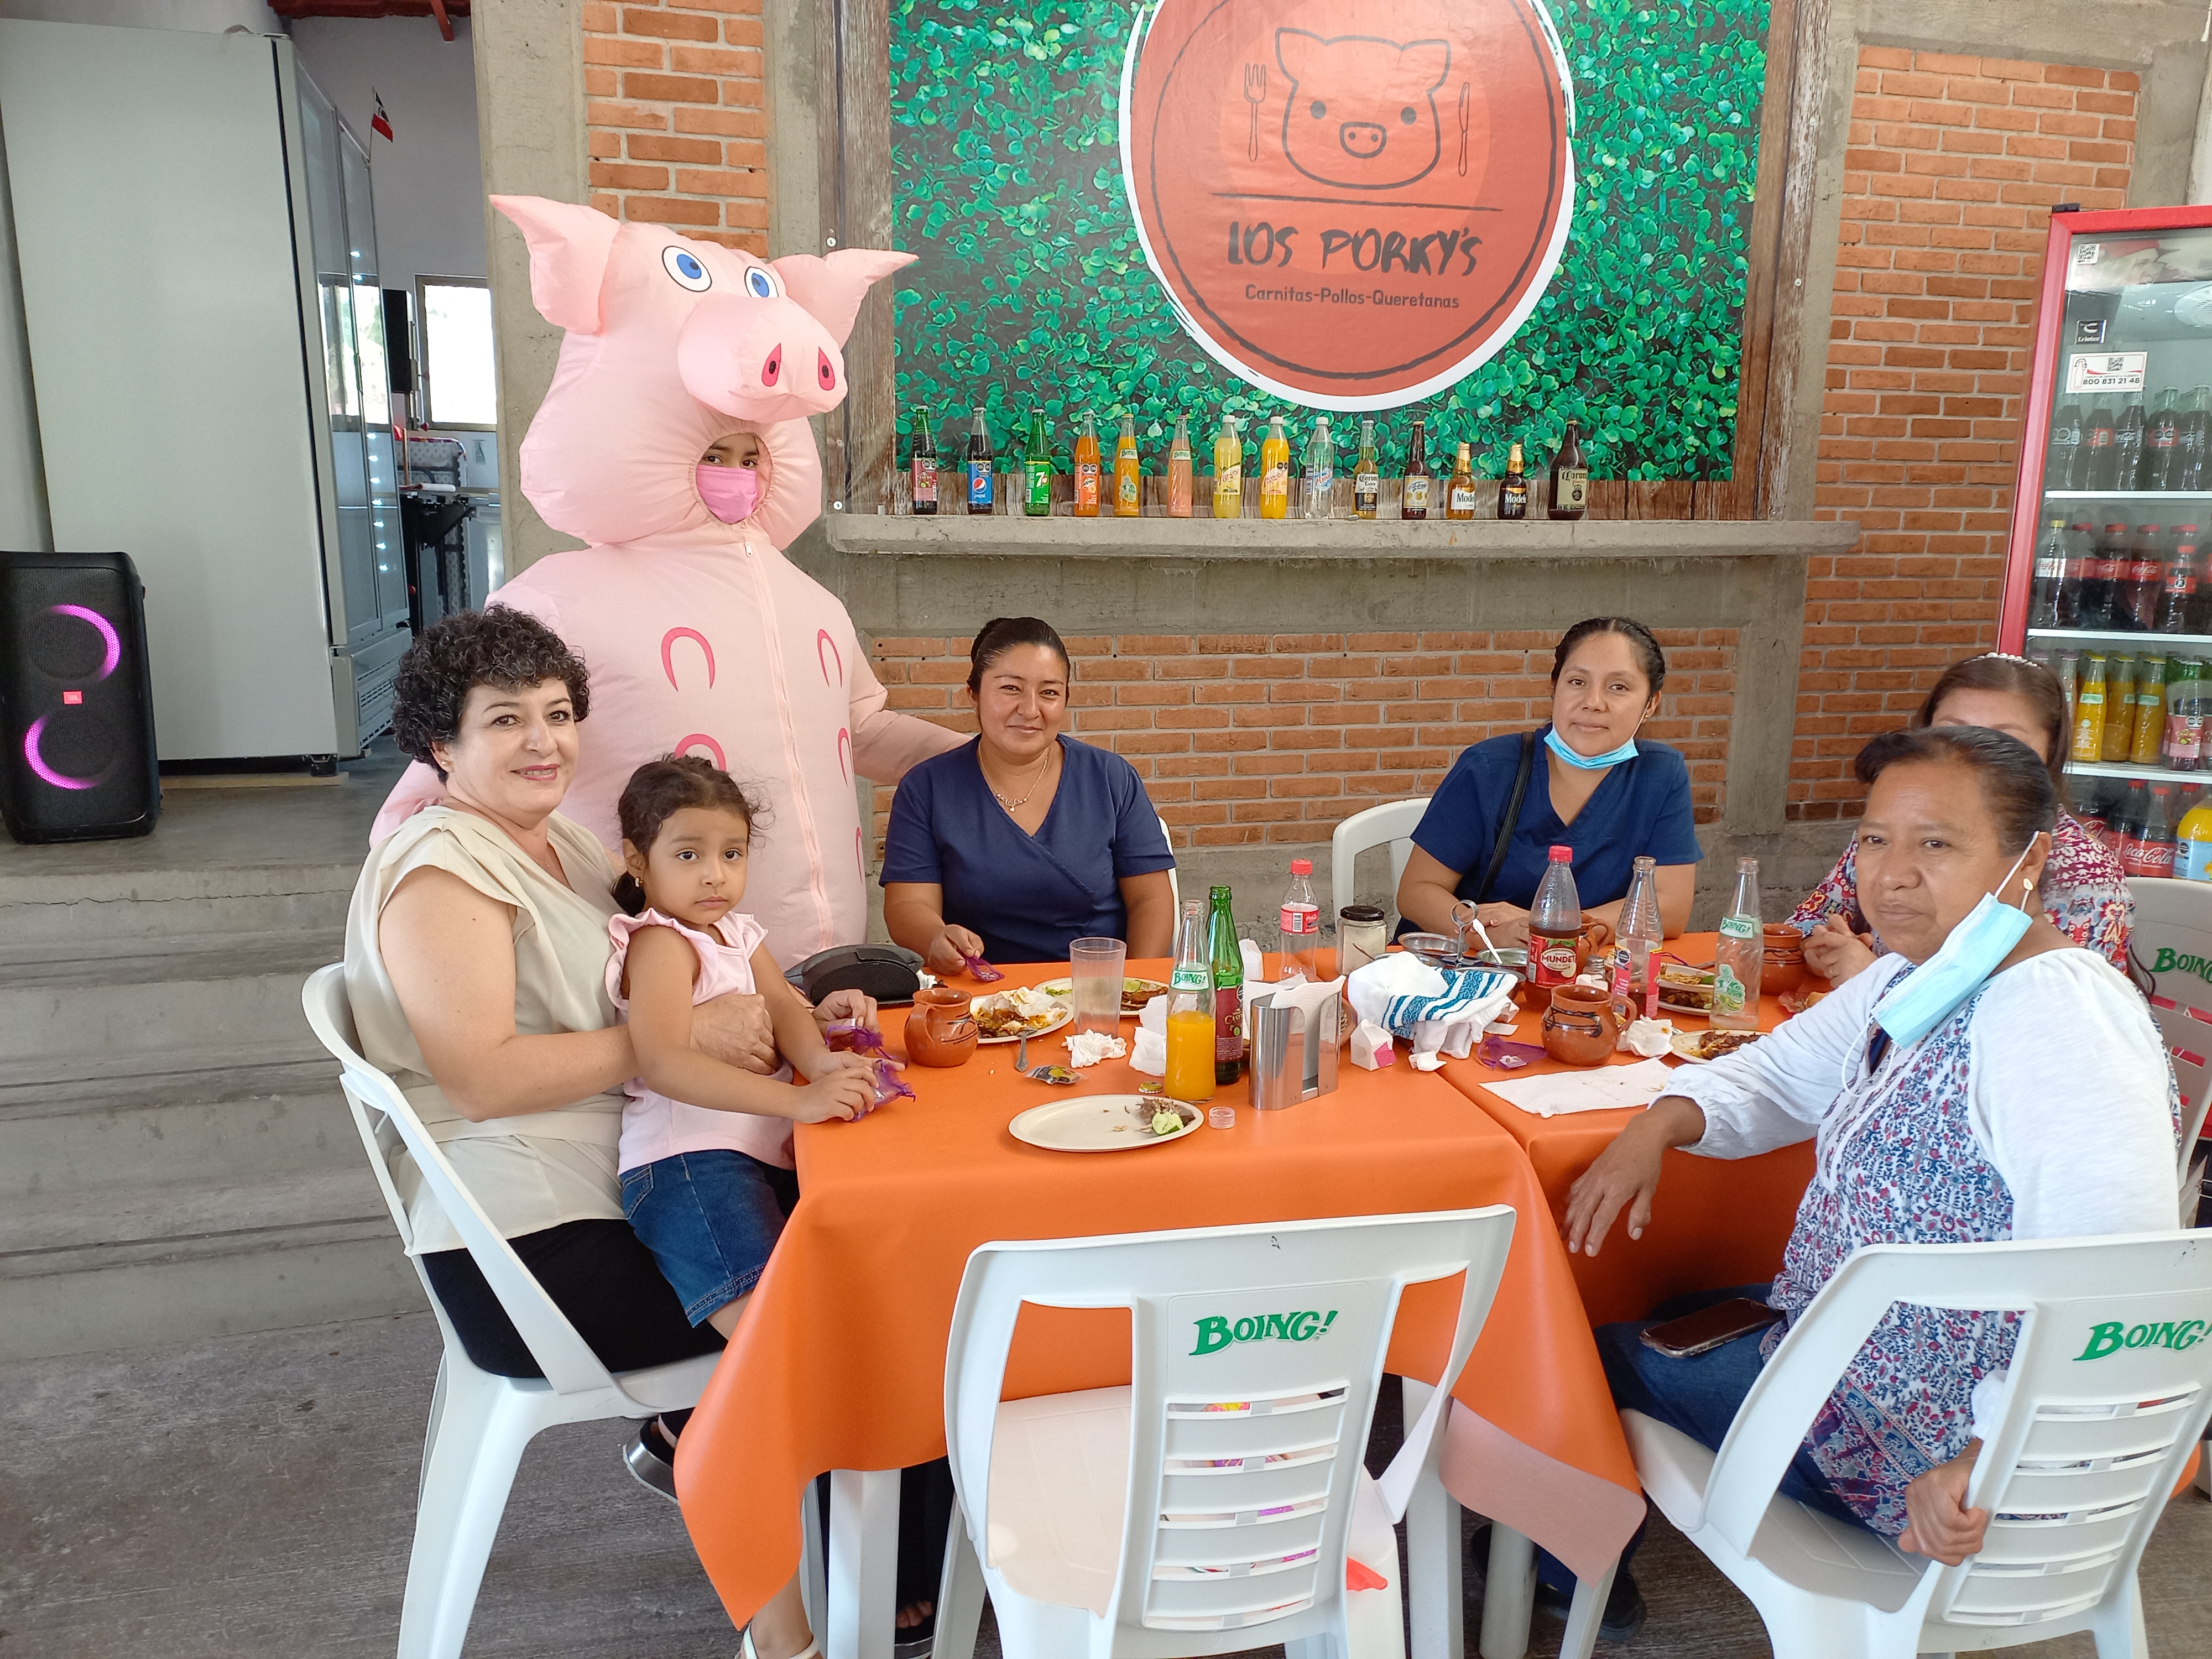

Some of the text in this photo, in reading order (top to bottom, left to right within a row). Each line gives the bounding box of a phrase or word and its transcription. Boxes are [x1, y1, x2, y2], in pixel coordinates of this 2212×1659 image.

[1228, 221, 1483, 276] LOS PORKY'S
[1245, 284, 1460, 308] Carnitas-Pollos-Queretanas
[1457, 493, 1475, 503] Mode
[1505, 493, 1526, 504] Model
[2124, 843, 2175, 864] Coca-Cola
[1542, 954, 1575, 963] MUNDET
[1173, 972, 1206, 985] BOING!
[1189, 1311, 1338, 1355] BOING!
[2073, 1319, 2212, 1361] BOING!
